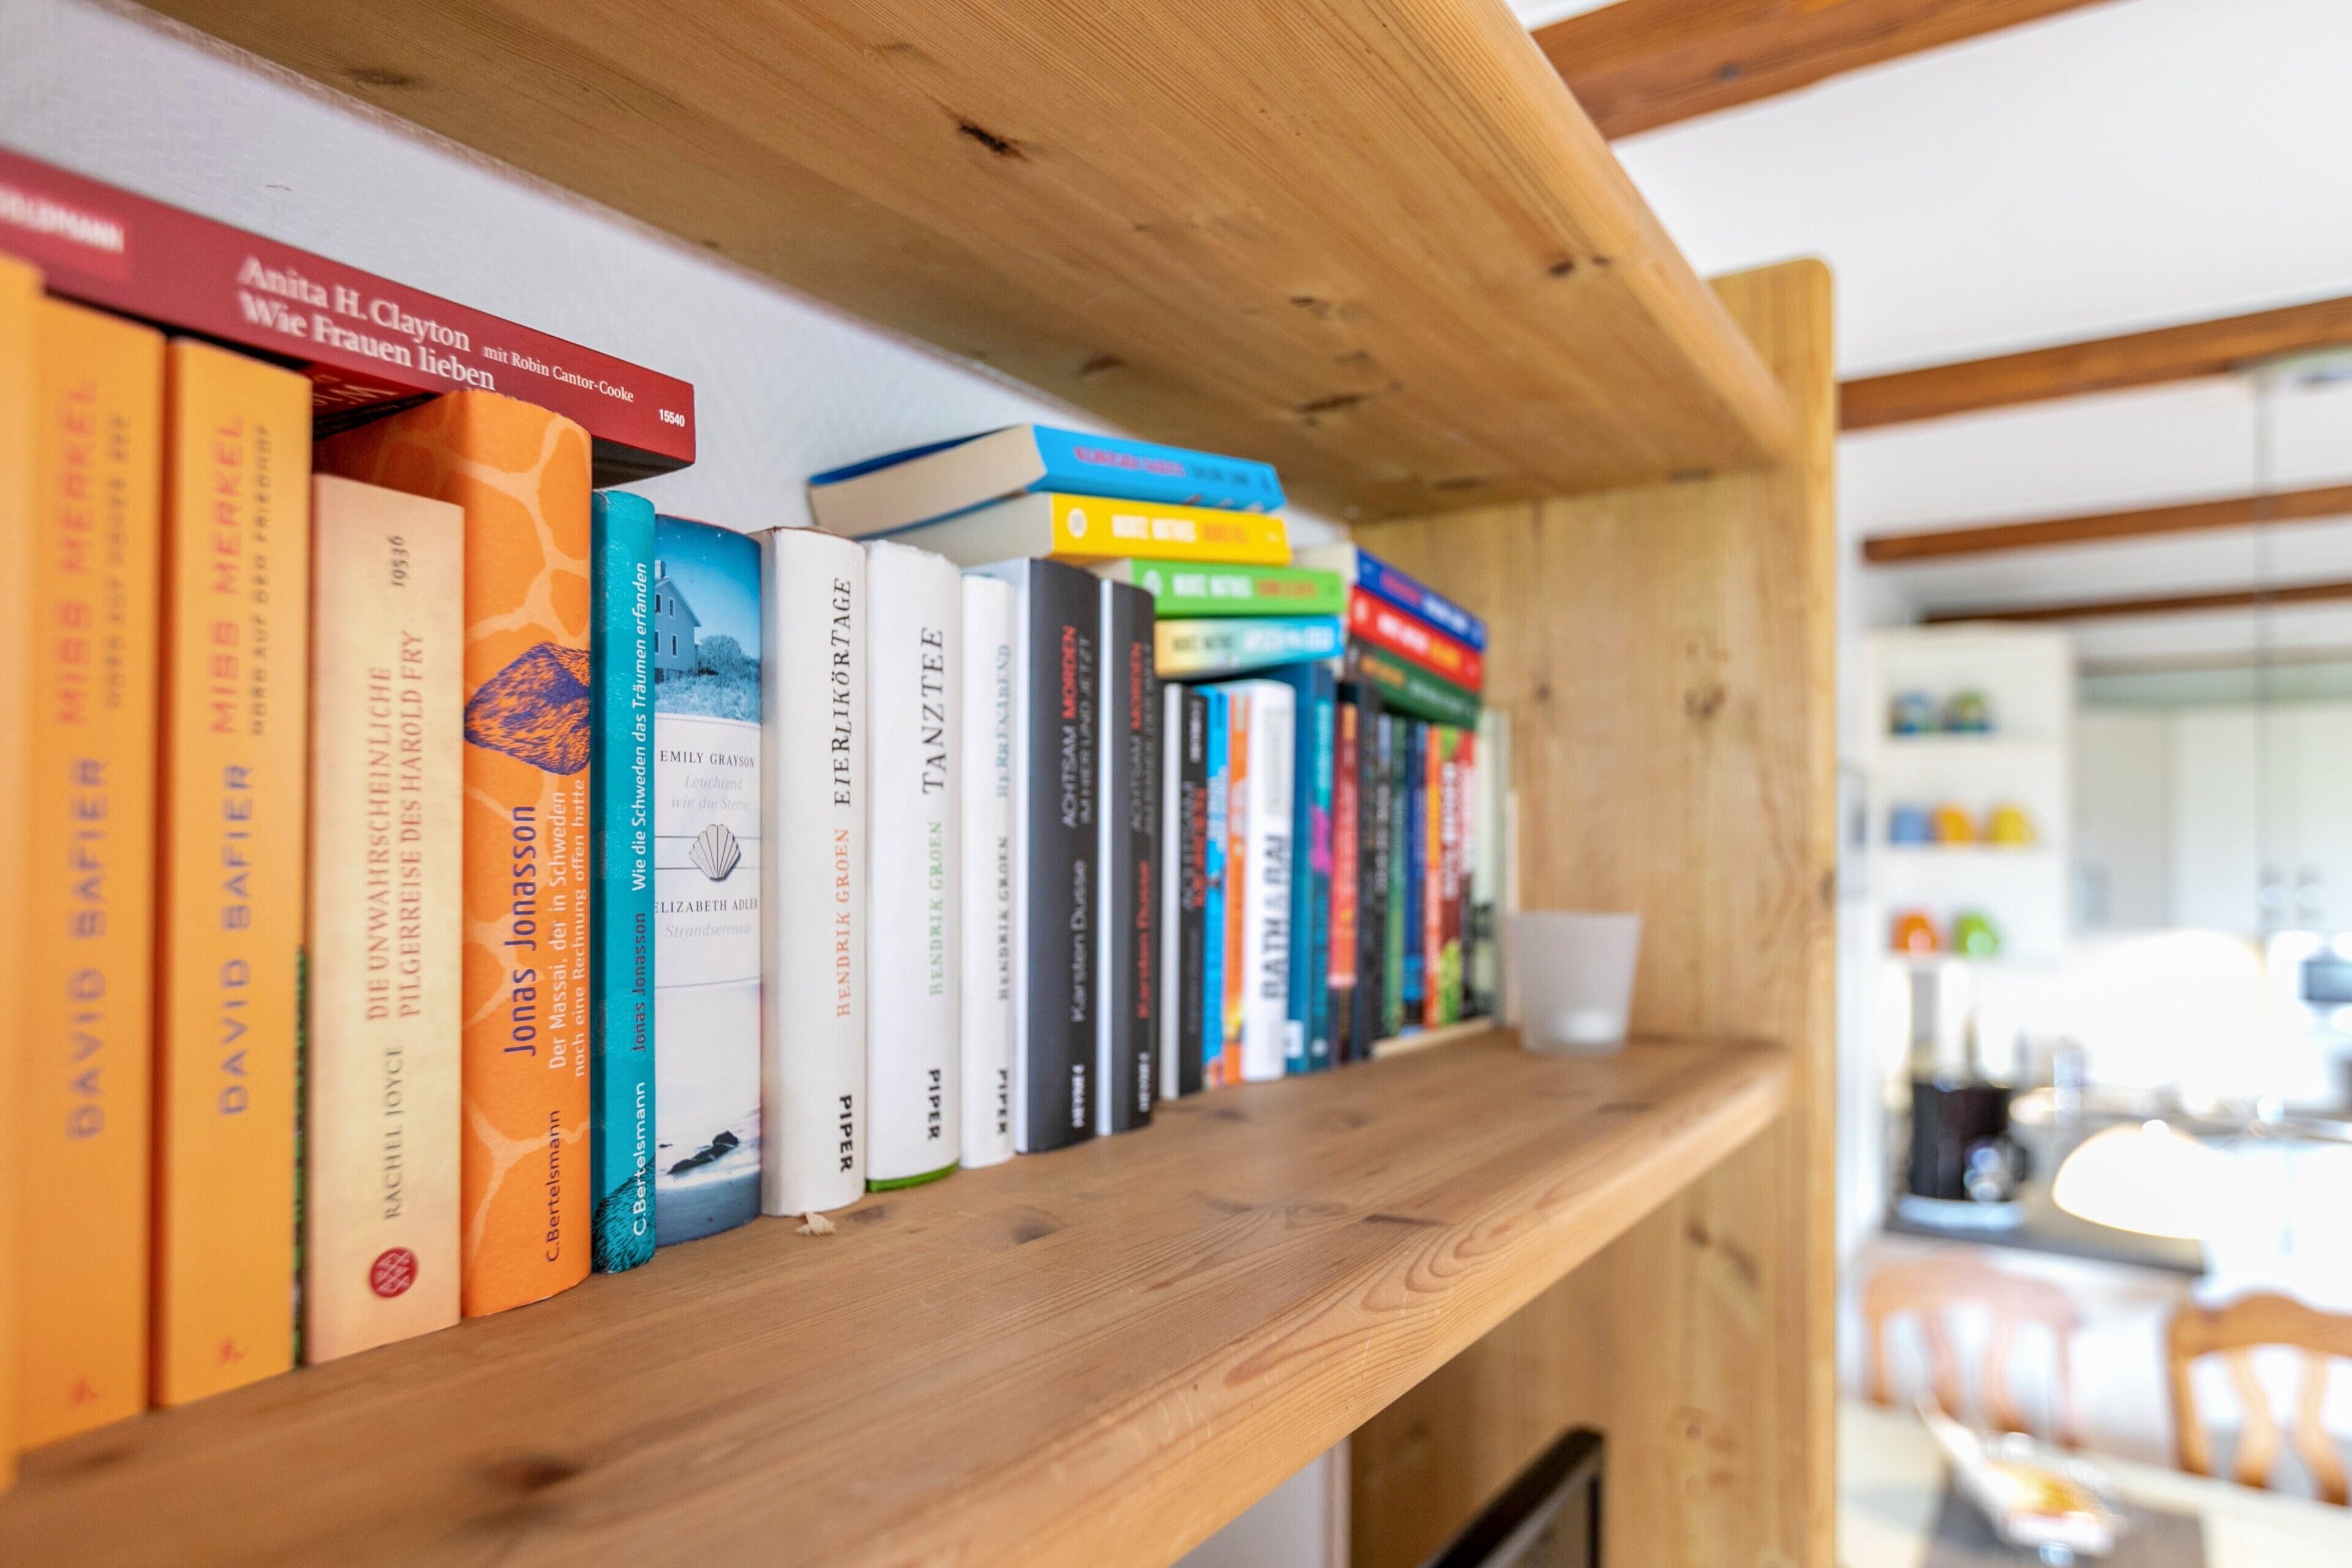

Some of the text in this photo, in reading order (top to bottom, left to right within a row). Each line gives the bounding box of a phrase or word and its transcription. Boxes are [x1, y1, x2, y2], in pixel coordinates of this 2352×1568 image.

[238, 255, 470, 352] Anita H. Clayton
[238, 290, 307, 337] Wie
[314, 314, 413, 368] Frauen
[420, 347, 495, 391] lieben
[483, 345, 634, 403] mit Robin Cantor-Cooke
[658, 408, 685, 428] 15540
[55, 380, 96, 723] MISS MERKEL
[207, 416, 243, 734] MISS MERKEL
[248, 423, 272, 736] MORD AUF DEM FRIEDHOF
[386, 536, 410, 587] 19536
[631, 563, 647, 891] Wie die Schweden das Träumen erfanden
[829, 578, 853, 807] EIERLIKÖRTAGE
[920, 627, 948, 794] TANZTEE
[995, 645, 1011, 799] HERRENABEND
[1061, 626, 1077, 829] ACHTSAM MORDEN
[1079, 636, 1092, 696] JETZT
[1079, 703, 1091, 747] UND
[1130, 641, 1142, 730] MORDEN
[398, 630, 424, 1019] PILGERREISE DES HAROLD FRY
[660, 750, 755, 768] EMILY GRAYSON
[671, 796, 750, 811] wie die Sterne
[684, 774, 742, 790] Leuchtend
[365, 667, 392, 1021] DIE UNWAHRSCHEINLICHE
[654, 899, 759, 914] ELIZABETH ADLER
[927, 821, 944, 997] HENDRIK GROEN
[997, 837, 1009, 1001] HENDRIK GROEN
[63, 758, 108, 1139] DAVID SAFIER
[218, 764, 254, 1115] DAVID SAFIER
[503, 807, 537, 1057] Jonas Jonasson
[548, 791, 569, 1069] Der Massai, der in Schweden
[571, 779, 586, 1077] noch eine Rechnung offen hatte
[631, 913, 646, 1052] Jonas Jonasson
[665, 922, 753, 938] Strandserenade
[834, 827, 852, 1018] HENDRIK GROEN
[1070, 861, 1087, 1023] Karsten Dusse
[1136, 860, 1151, 1017] Karsten Dusse
[383, 1046, 405, 1221] RACHEL JOYCE
[633, 1082, 646, 1236] C.Bertelsmann
[838, 1095, 854, 1172] PIPER
[927, 1069, 942, 1140] PIPER
[997, 1068, 1008, 1135] PIPER
[544, 1110, 560, 1263] C.Bertelsmann
